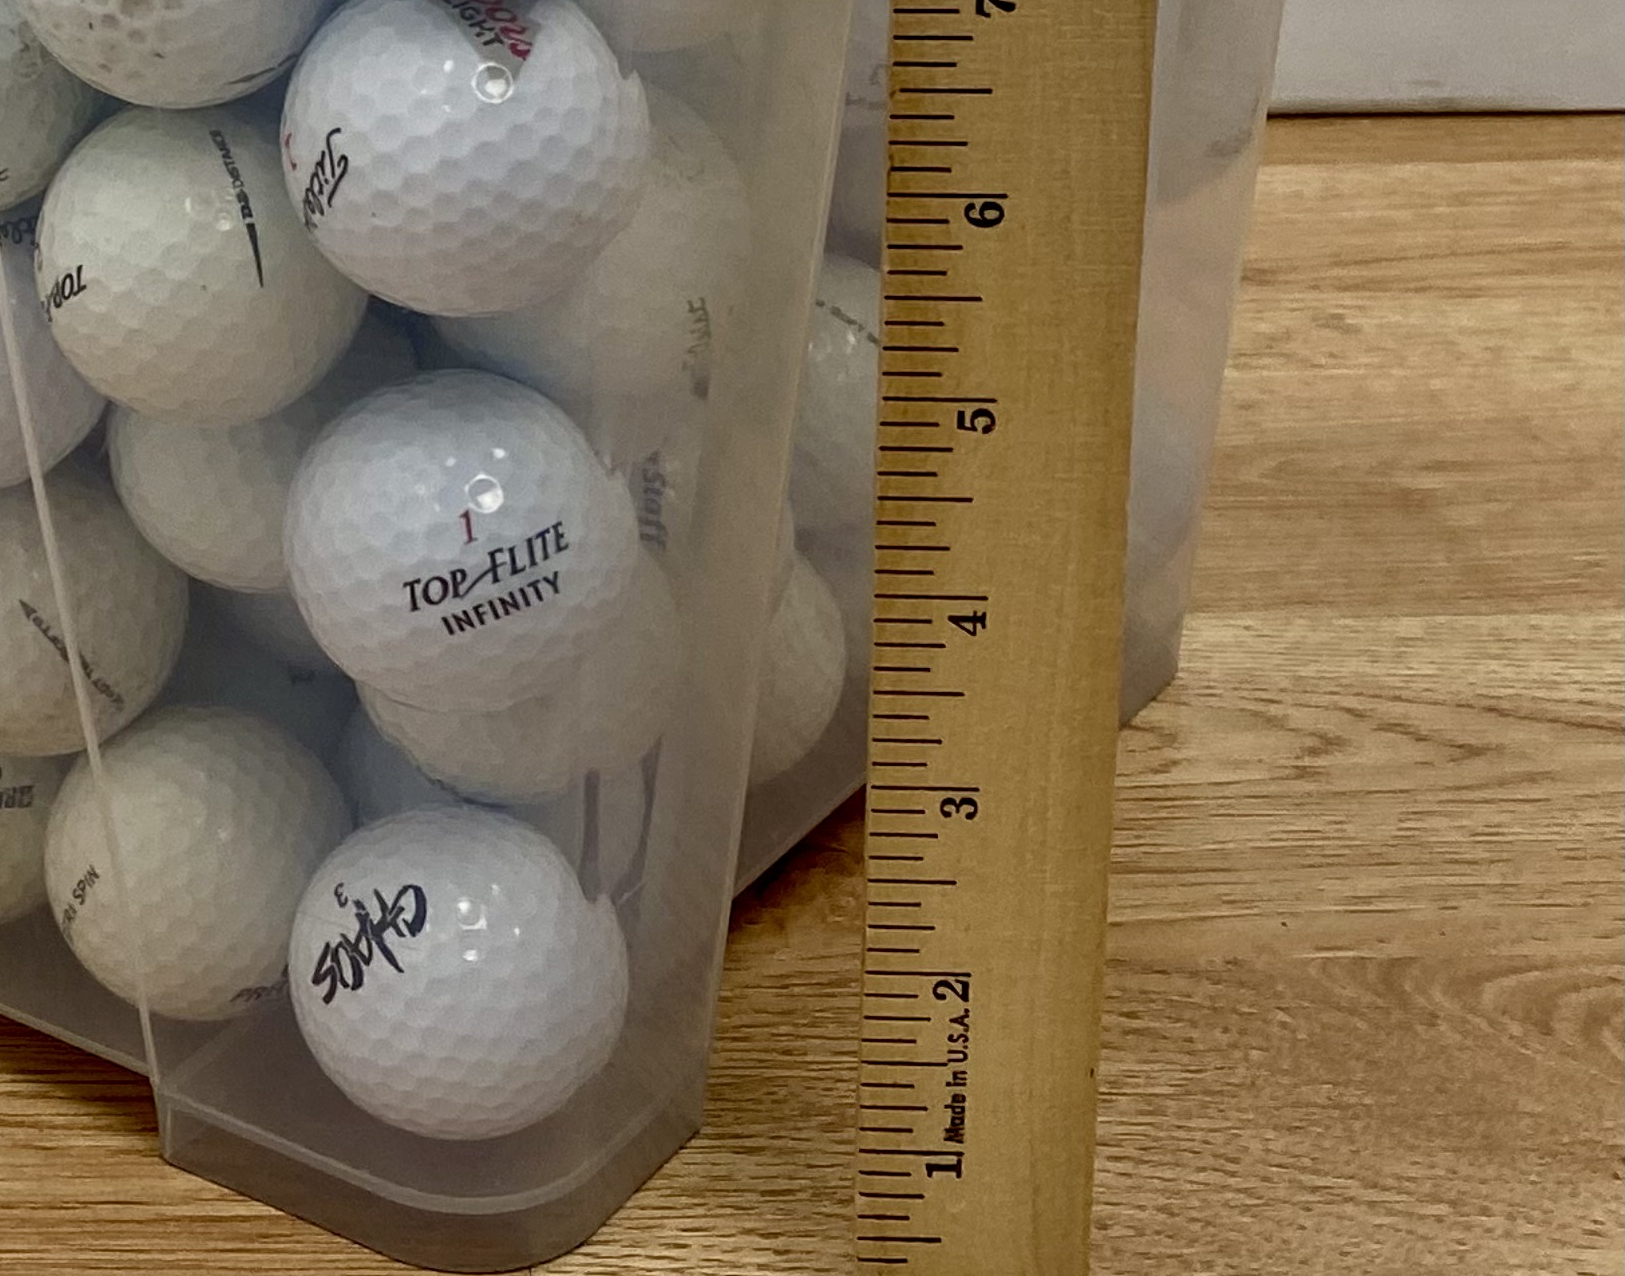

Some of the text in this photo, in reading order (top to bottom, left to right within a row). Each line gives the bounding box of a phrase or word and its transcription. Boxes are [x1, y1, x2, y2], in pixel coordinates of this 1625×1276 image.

[964, 201, 1006, 228] 6
[956, 407, 996, 435] 5
[459, 508, 478, 546] 1
[402, 520, 570, 613] TOP FLITE
[440, 570, 561, 636] INFINITY
[948, 610, 988, 637] 4
[939, 795, 980, 821] 3
[72, 864, 101, 906] SPIN
[932, 979, 970, 1004] 2
[943, 1007, 972, 1145] Made in U.S.A.
[925, 1157, 963, 1180] 1
